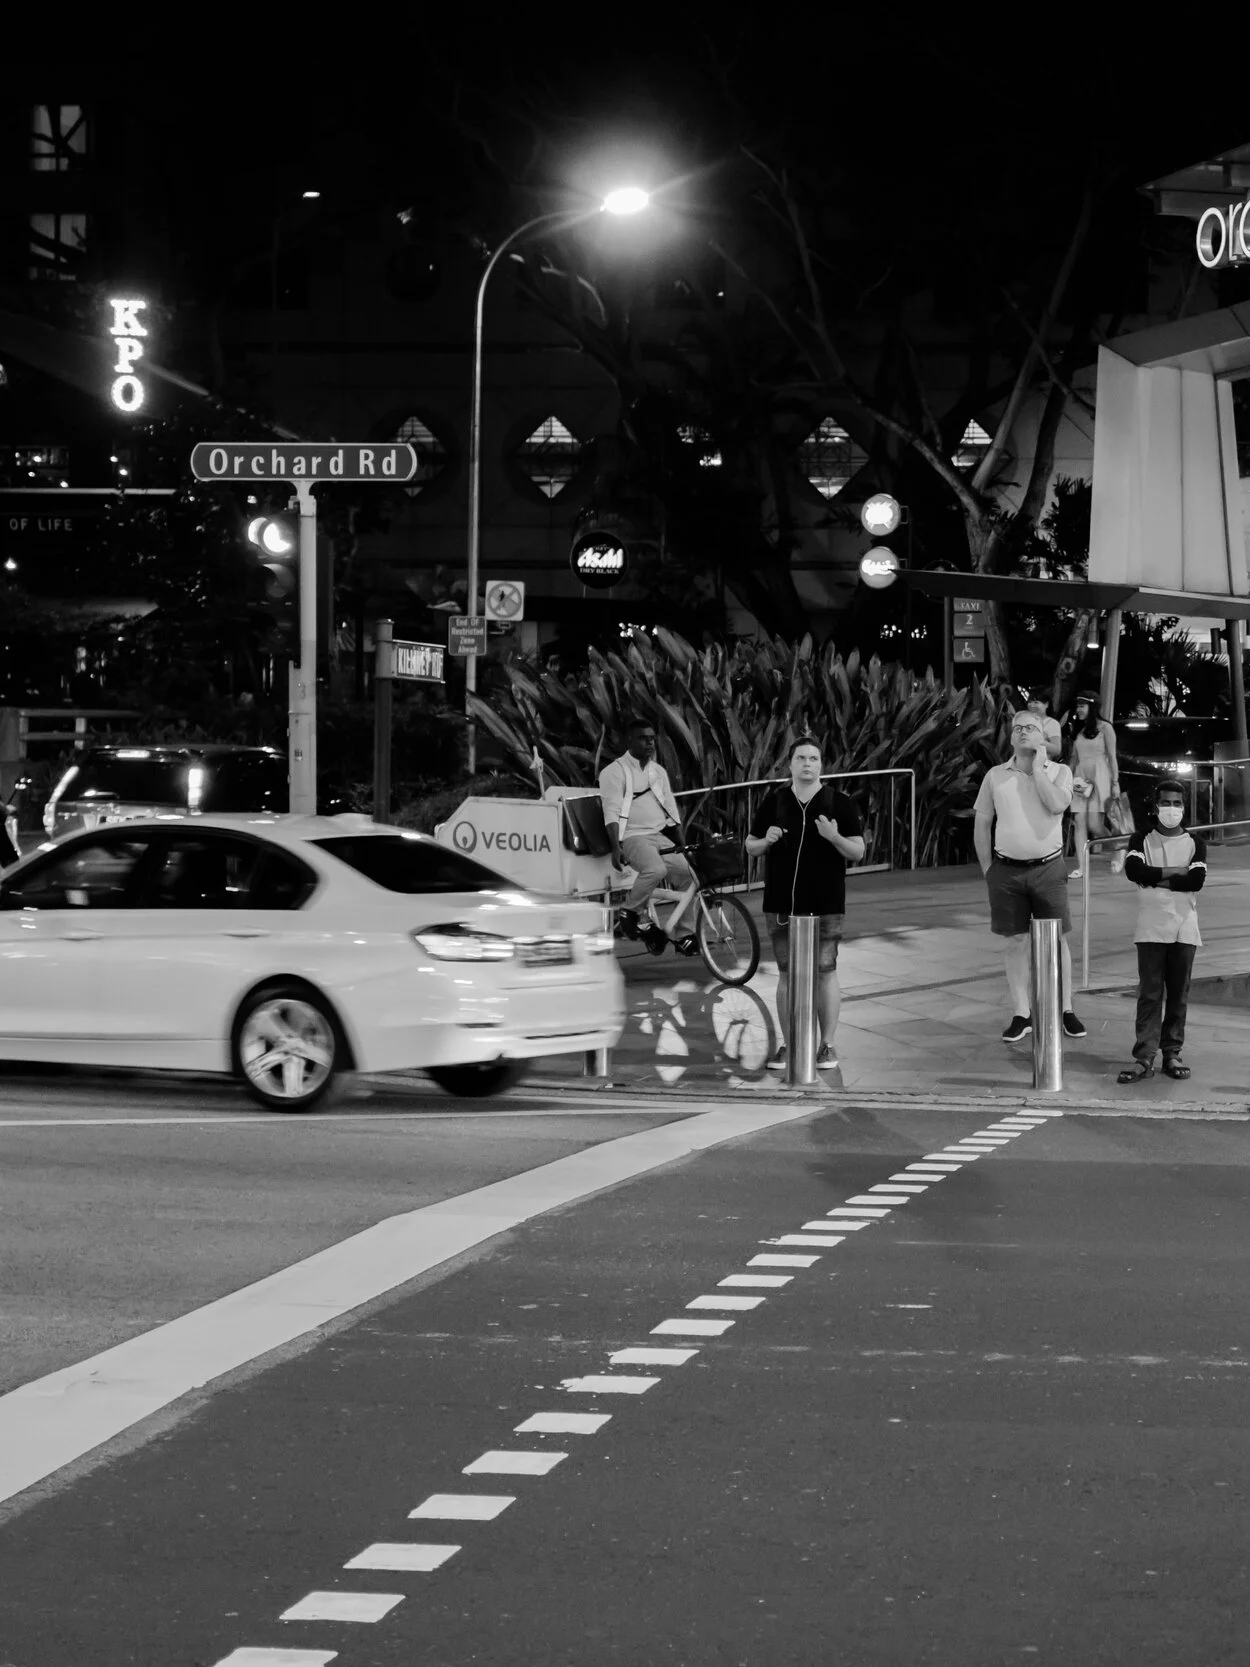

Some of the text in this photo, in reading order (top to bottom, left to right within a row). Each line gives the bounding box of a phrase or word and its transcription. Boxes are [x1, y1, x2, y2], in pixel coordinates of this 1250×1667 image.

[109, 299, 148, 412] KPO
[209, 448, 396, 475] Orchard Rd
[9, 518, 73, 532] OF LIFE
[960, 602, 980, 611] TAXI
[966, 614, 973, 625] 2
[481, 831, 552, 853] VEOLIA
